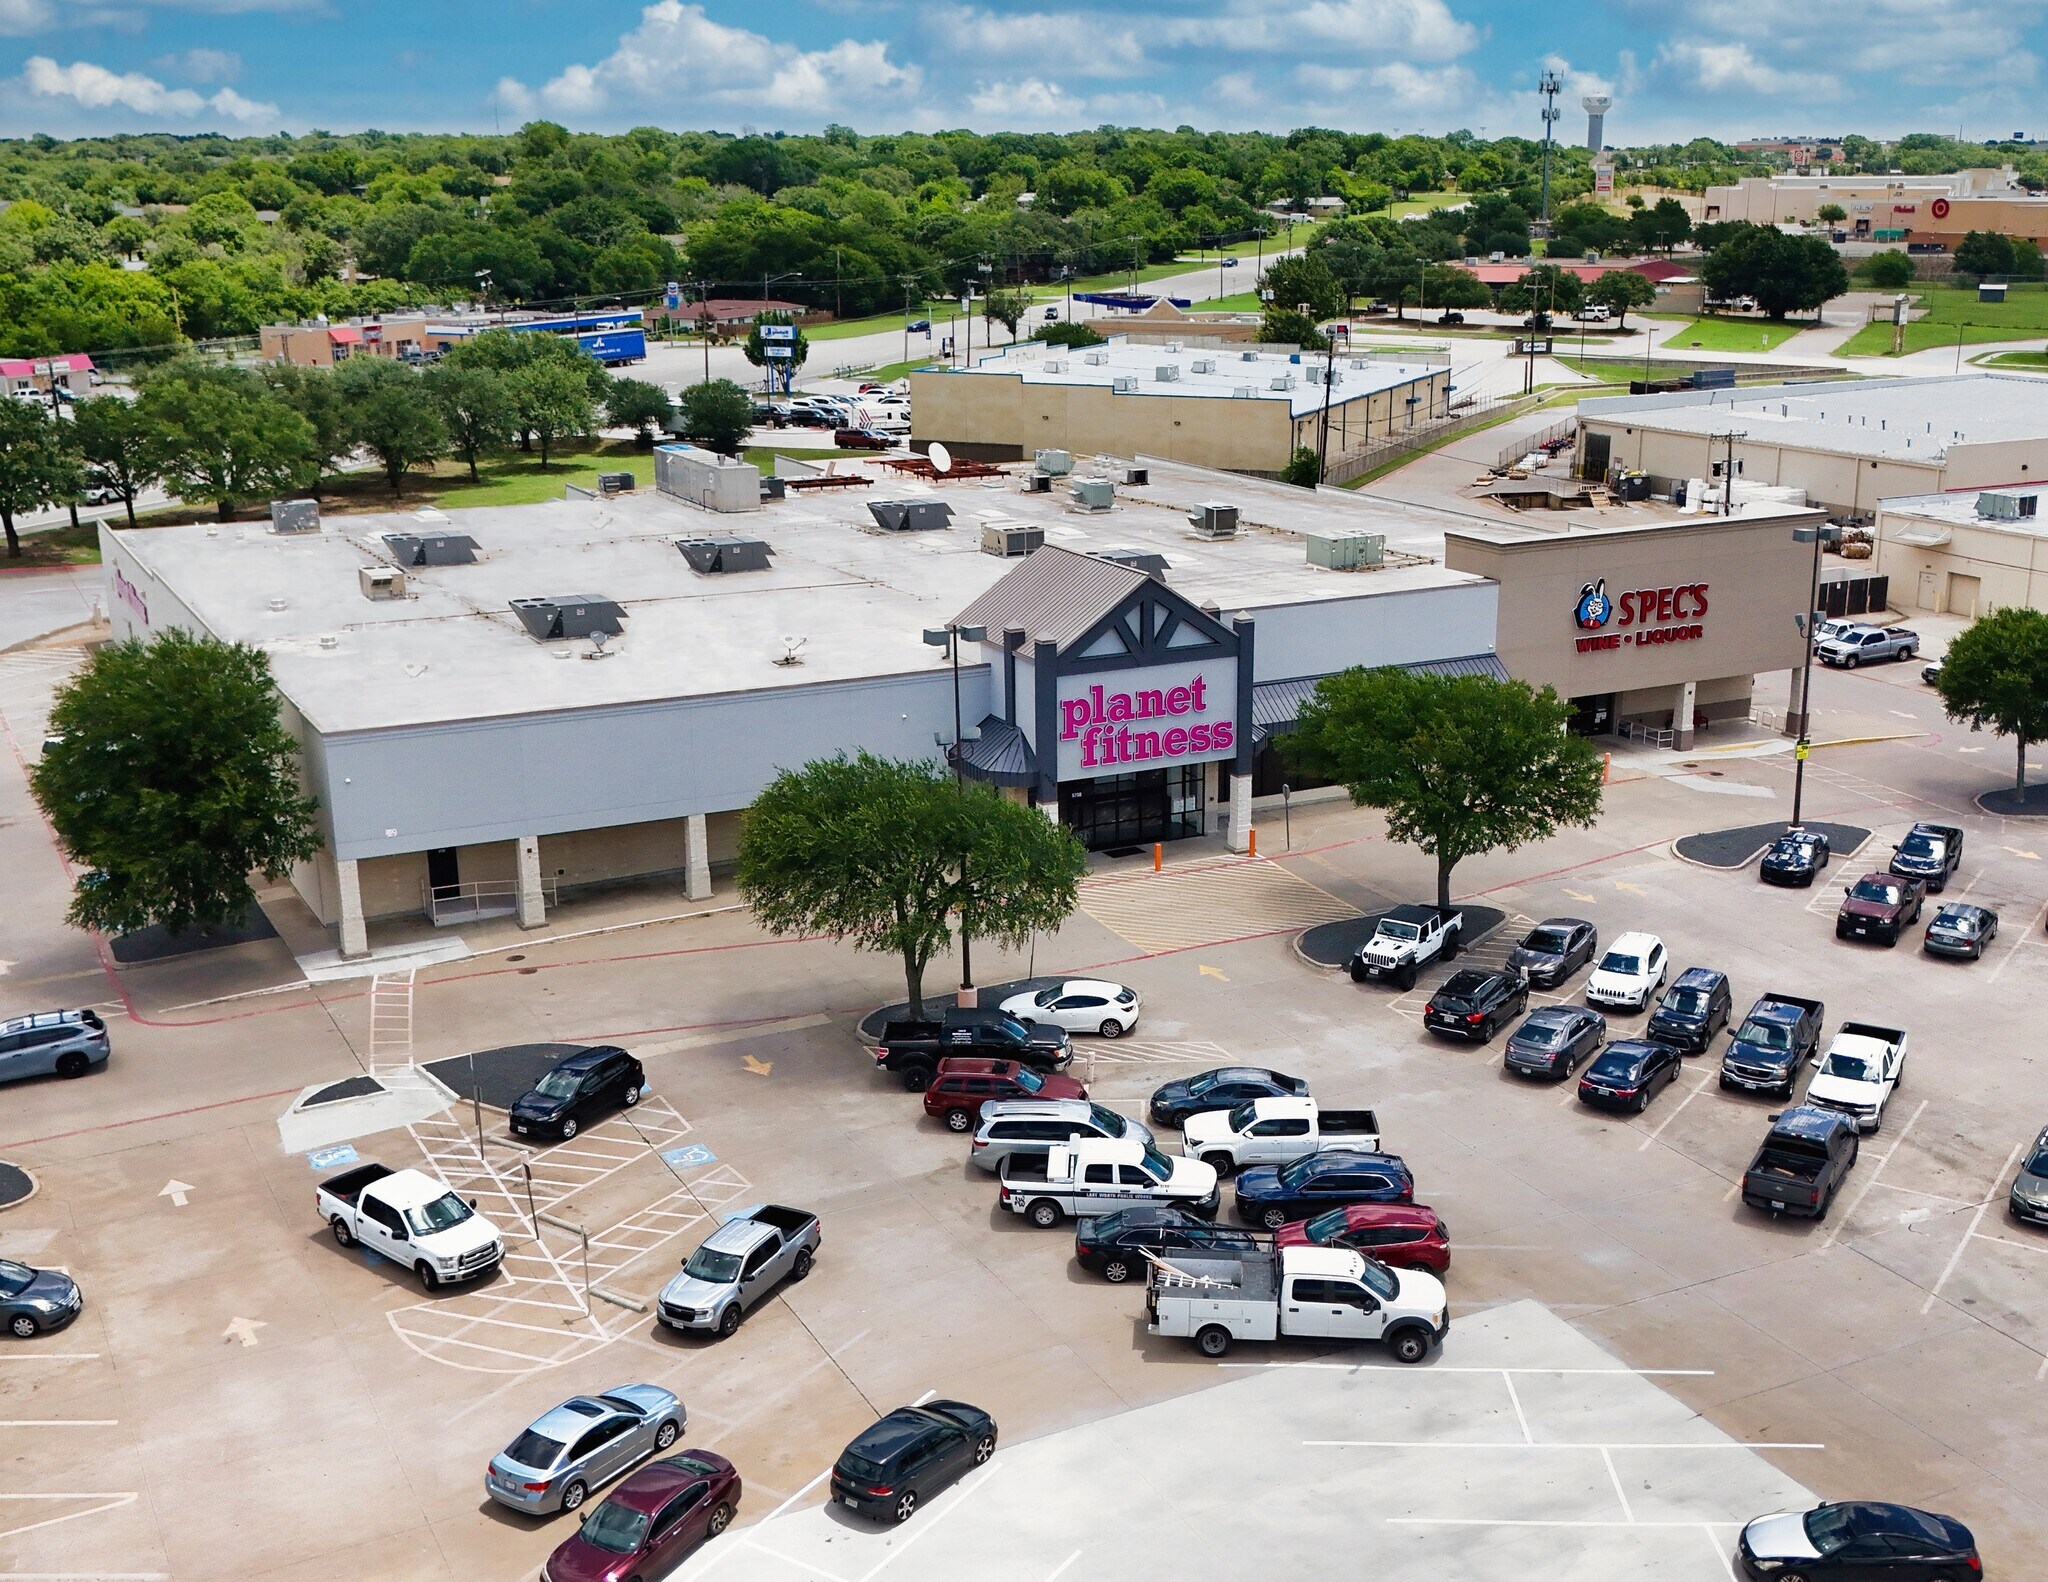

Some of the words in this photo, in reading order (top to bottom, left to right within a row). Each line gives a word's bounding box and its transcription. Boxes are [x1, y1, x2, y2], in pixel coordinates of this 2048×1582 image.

[1617, 582, 1709, 626] SPEC'S
[1574, 633, 1621, 654] WINE
[1635, 623, 1703, 647] LIQUOR
[1060, 673, 1207, 741] planet
[1081, 720, 1234, 769] fitness
